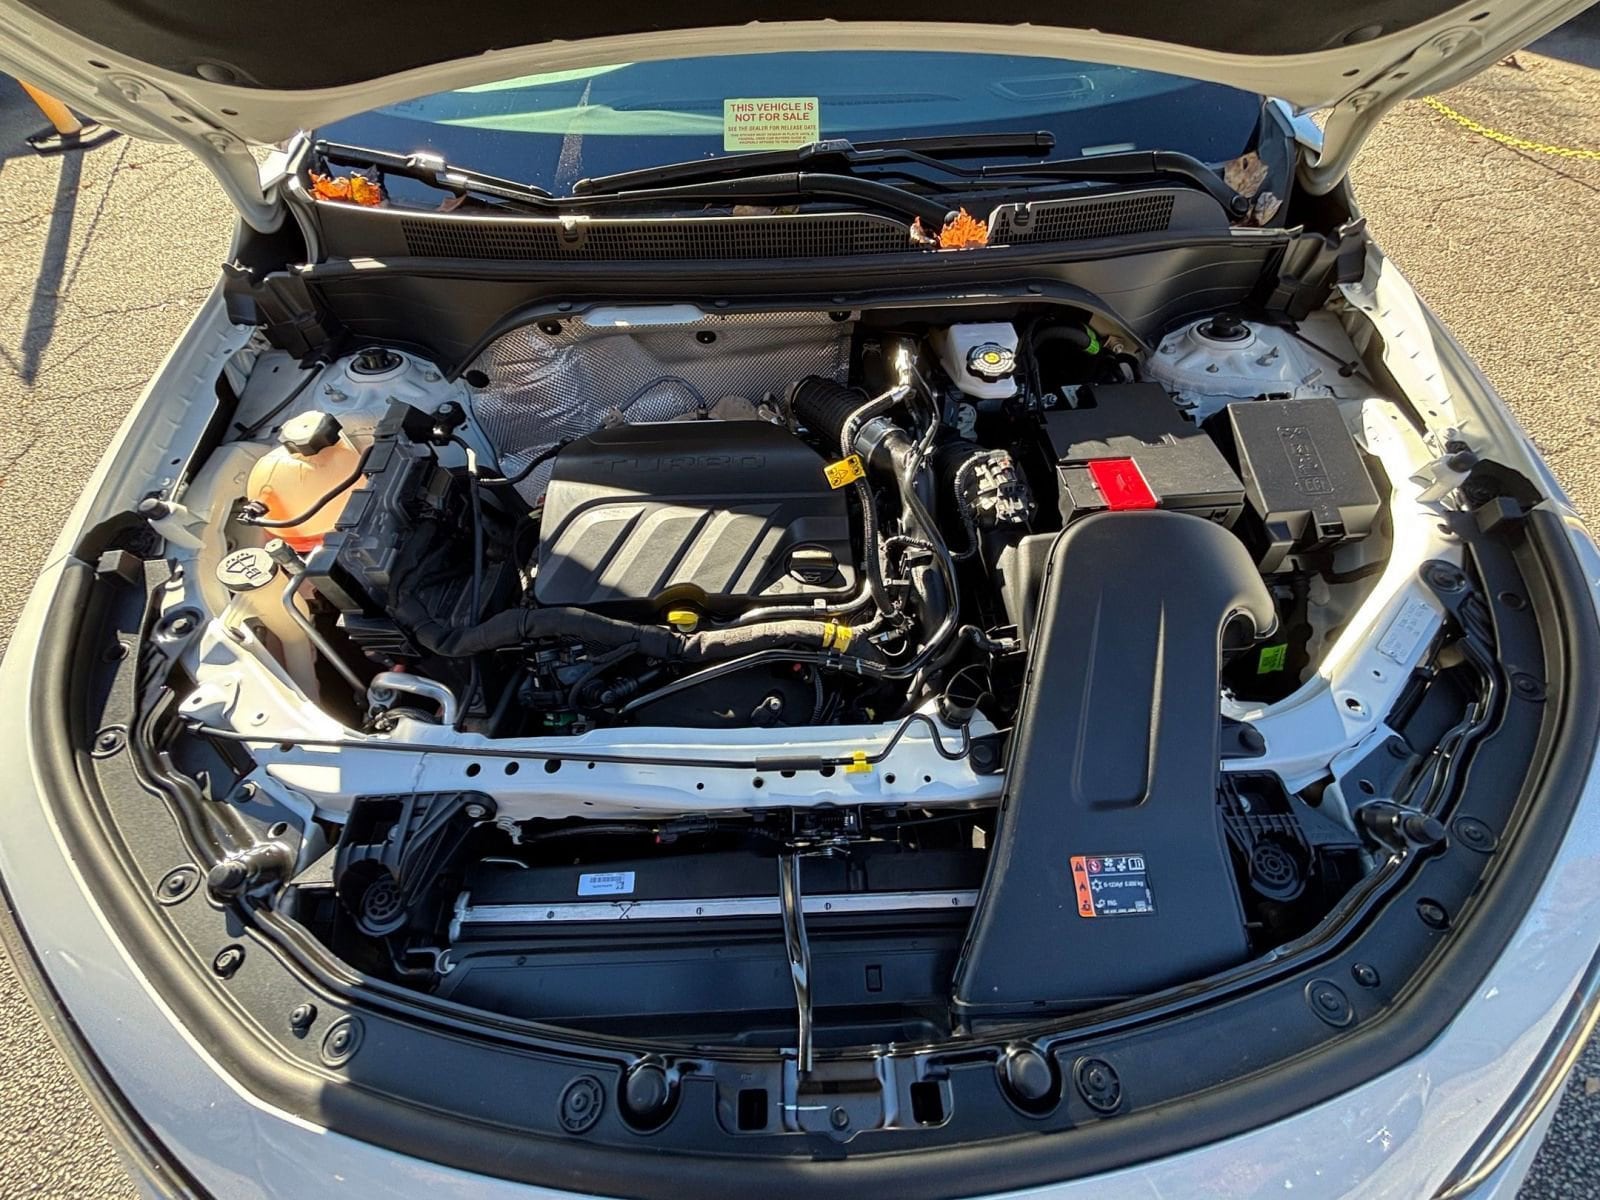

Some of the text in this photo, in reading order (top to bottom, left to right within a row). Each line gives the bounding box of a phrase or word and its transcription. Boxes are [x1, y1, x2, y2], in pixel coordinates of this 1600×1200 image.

[730, 102, 814, 112] THIS VEHICLE IS
[735, 112, 810, 122] NOT FOR SALE
[592, 454, 768, 474] TURBO
